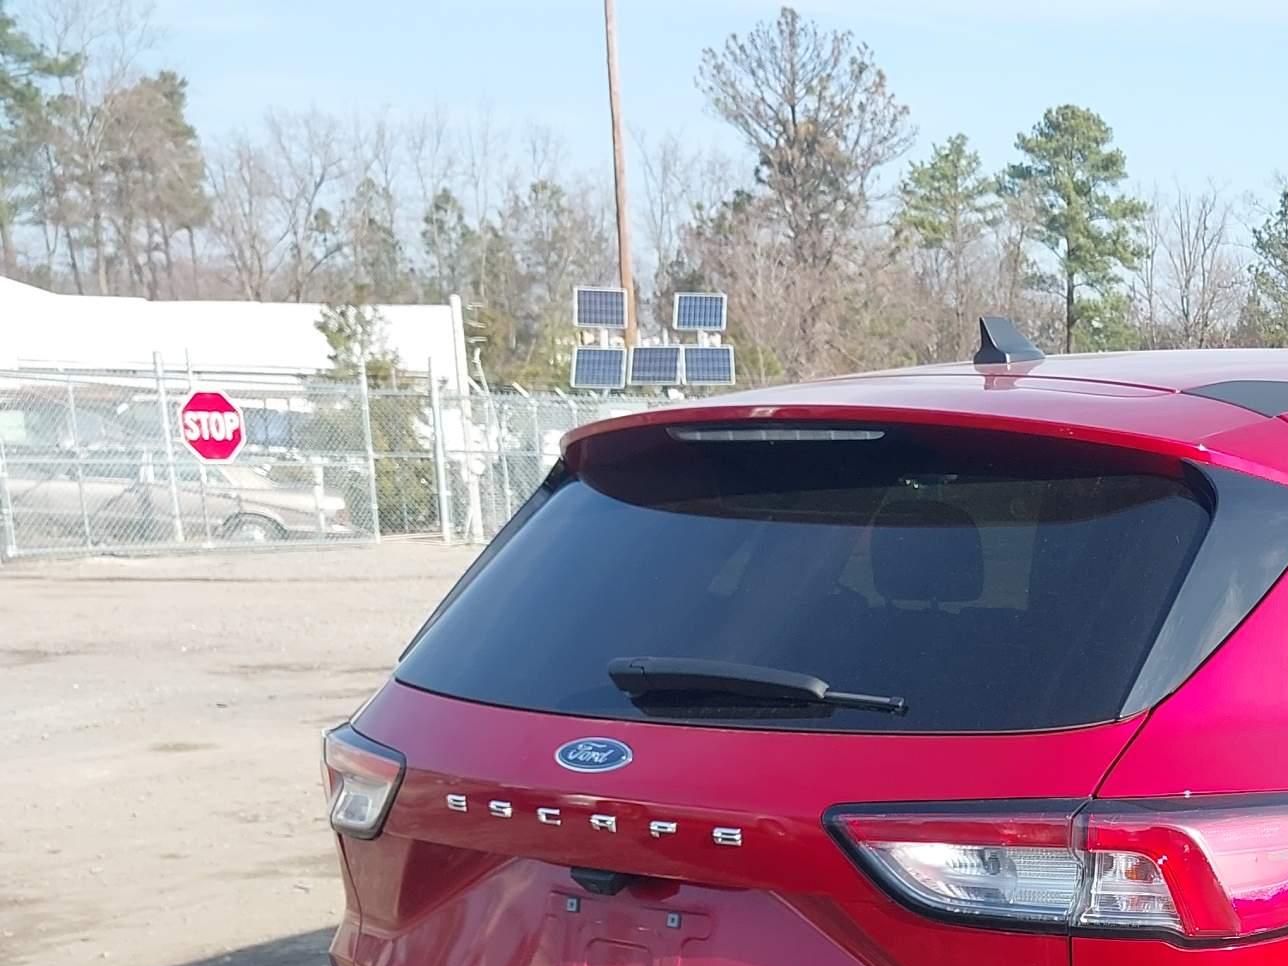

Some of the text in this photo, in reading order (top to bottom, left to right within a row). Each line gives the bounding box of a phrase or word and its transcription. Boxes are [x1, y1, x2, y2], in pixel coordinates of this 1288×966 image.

[184, 411, 240, 441] STOP
[567, 742, 614, 763] Ford
[446, 794, 742, 847] ESCAPE
